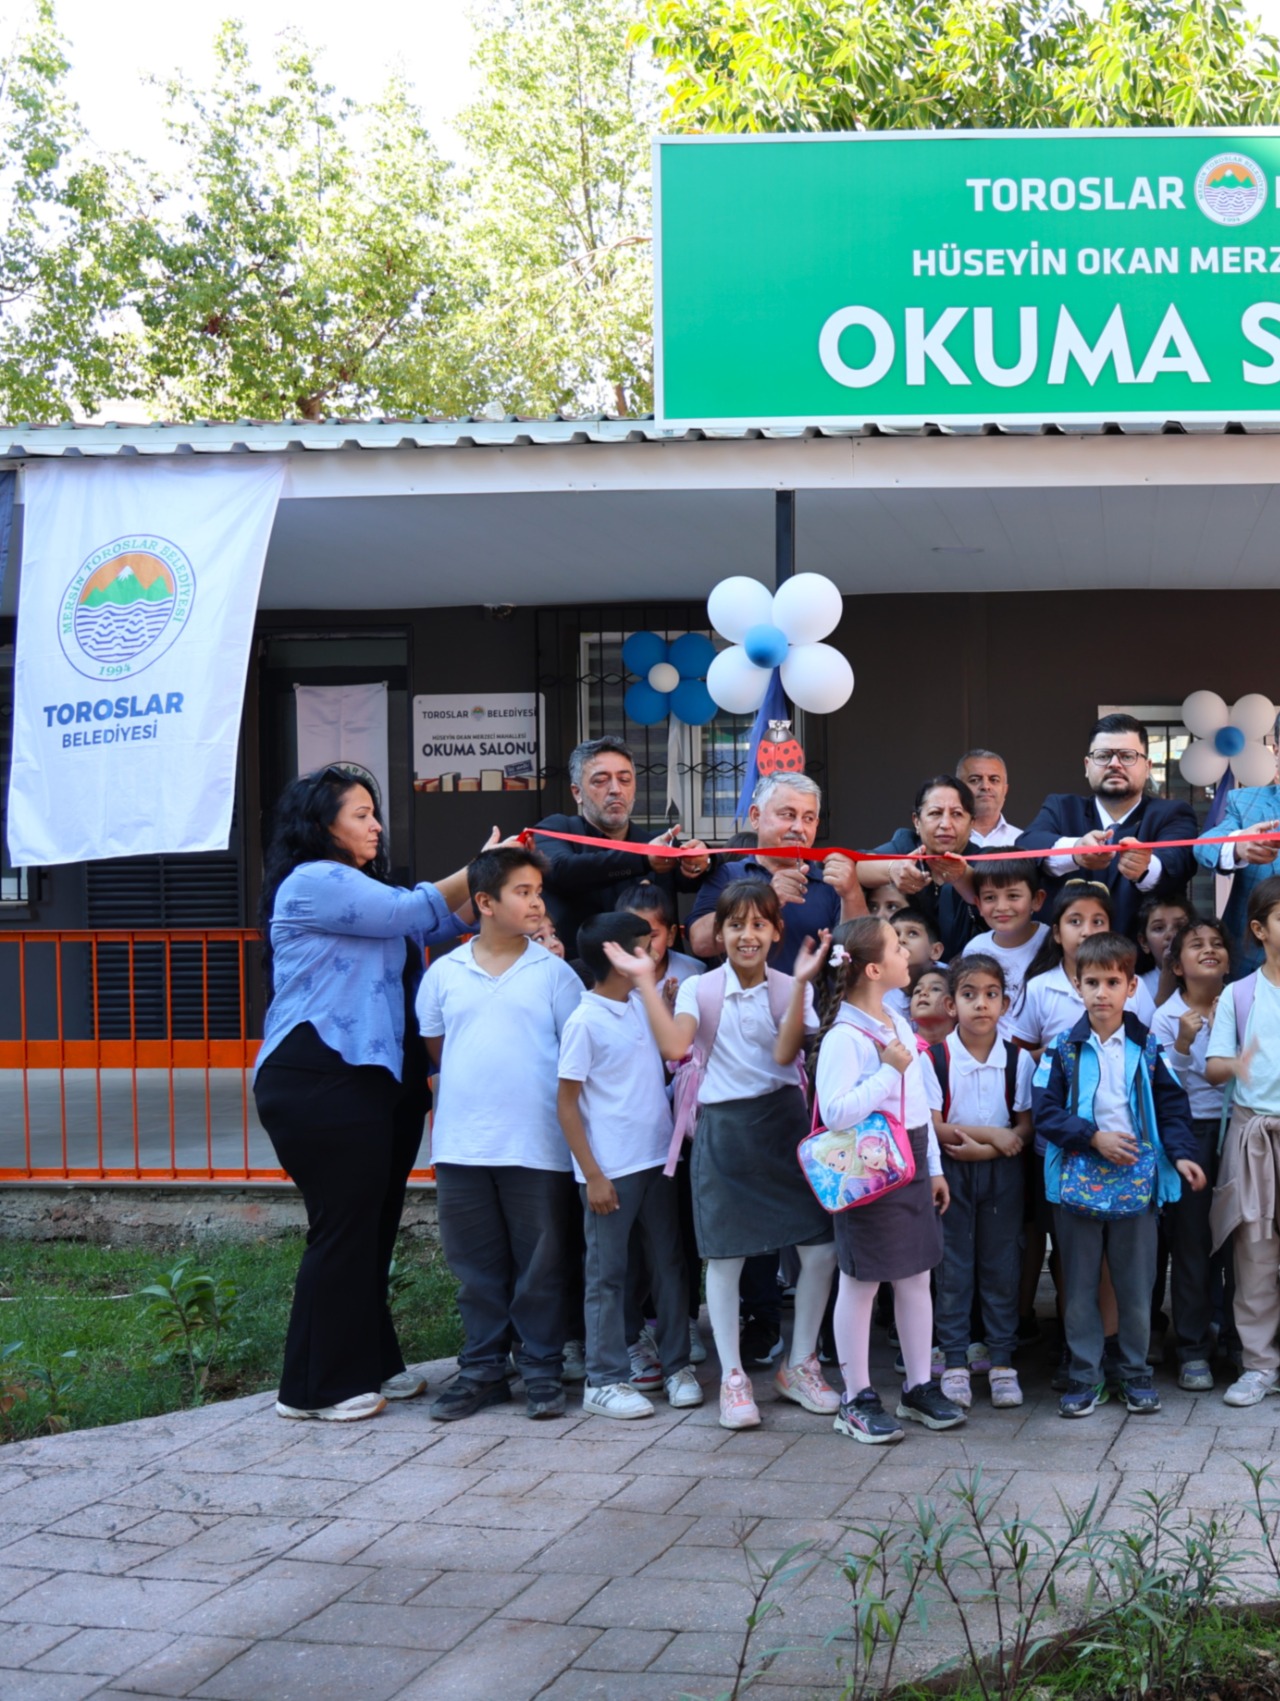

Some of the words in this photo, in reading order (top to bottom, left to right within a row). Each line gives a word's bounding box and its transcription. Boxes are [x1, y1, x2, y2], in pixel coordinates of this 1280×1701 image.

[966, 176, 1186, 211] TOROSLAR
[912, 240, 1067, 276] HÜSEYİN
[1077, 247, 1179, 275] OKAN
[818, 302, 1212, 388] OKUMA
[63, 576, 84, 634] MERSİN
[85, 539, 158, 573] TOROSLAR
[160, 546, 193, 622] BELEDİYESİ
[43, 692, 185, 728] TOROSLAR
[422, 710, 469, 719] TOROSLAR
[61, 719, 158, 748] BELEDİYESİ
[422, 743, 476, 757] OKUMA
[480, 742, 537, 756] SALONU
